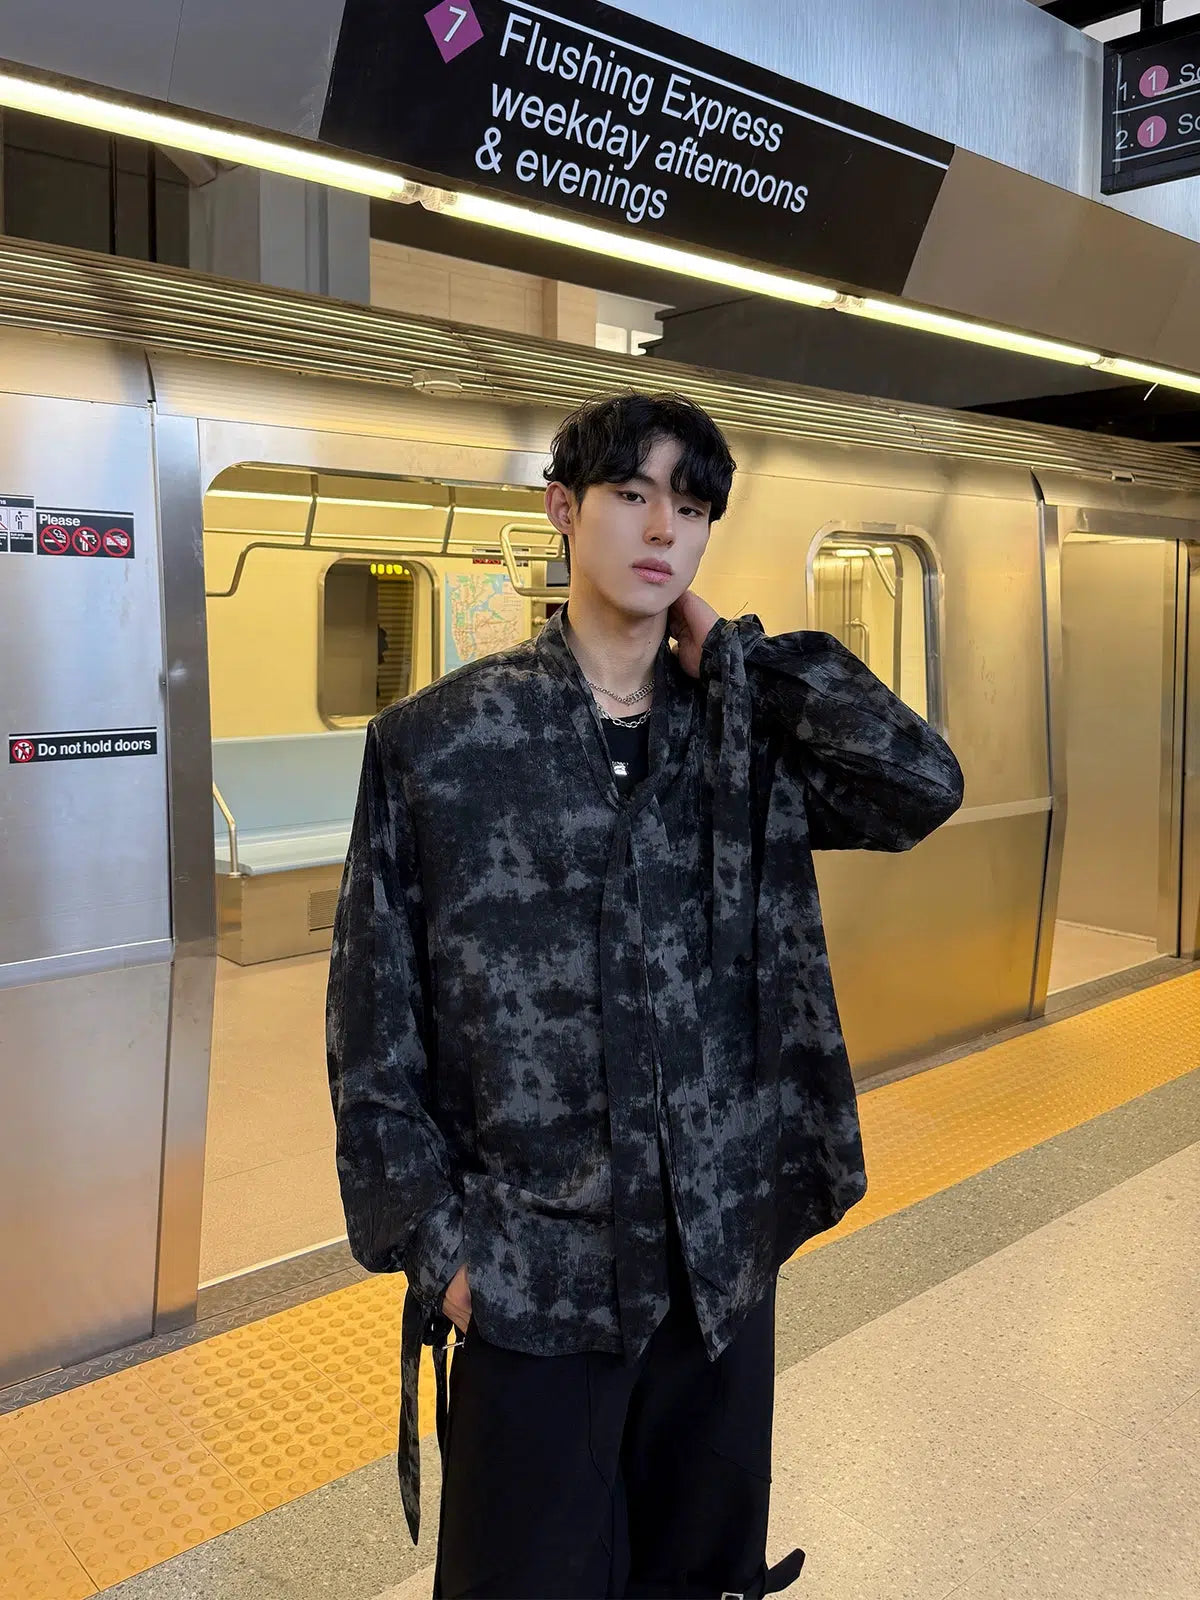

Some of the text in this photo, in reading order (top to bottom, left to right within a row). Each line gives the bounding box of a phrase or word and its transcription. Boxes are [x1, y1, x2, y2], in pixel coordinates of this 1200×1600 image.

[444, 6, 784, 152] 7 Flushing Express
[1147, 71, 1157, 92] 1
[1146, 122, 1155, 143] 1
[492, 83, 809, 213] weekday afternoons
[475, 127, 668, 224] & evenings
[39, 513, 81, 527] Please
[38, 738, 152, 757] Do not hold doors
